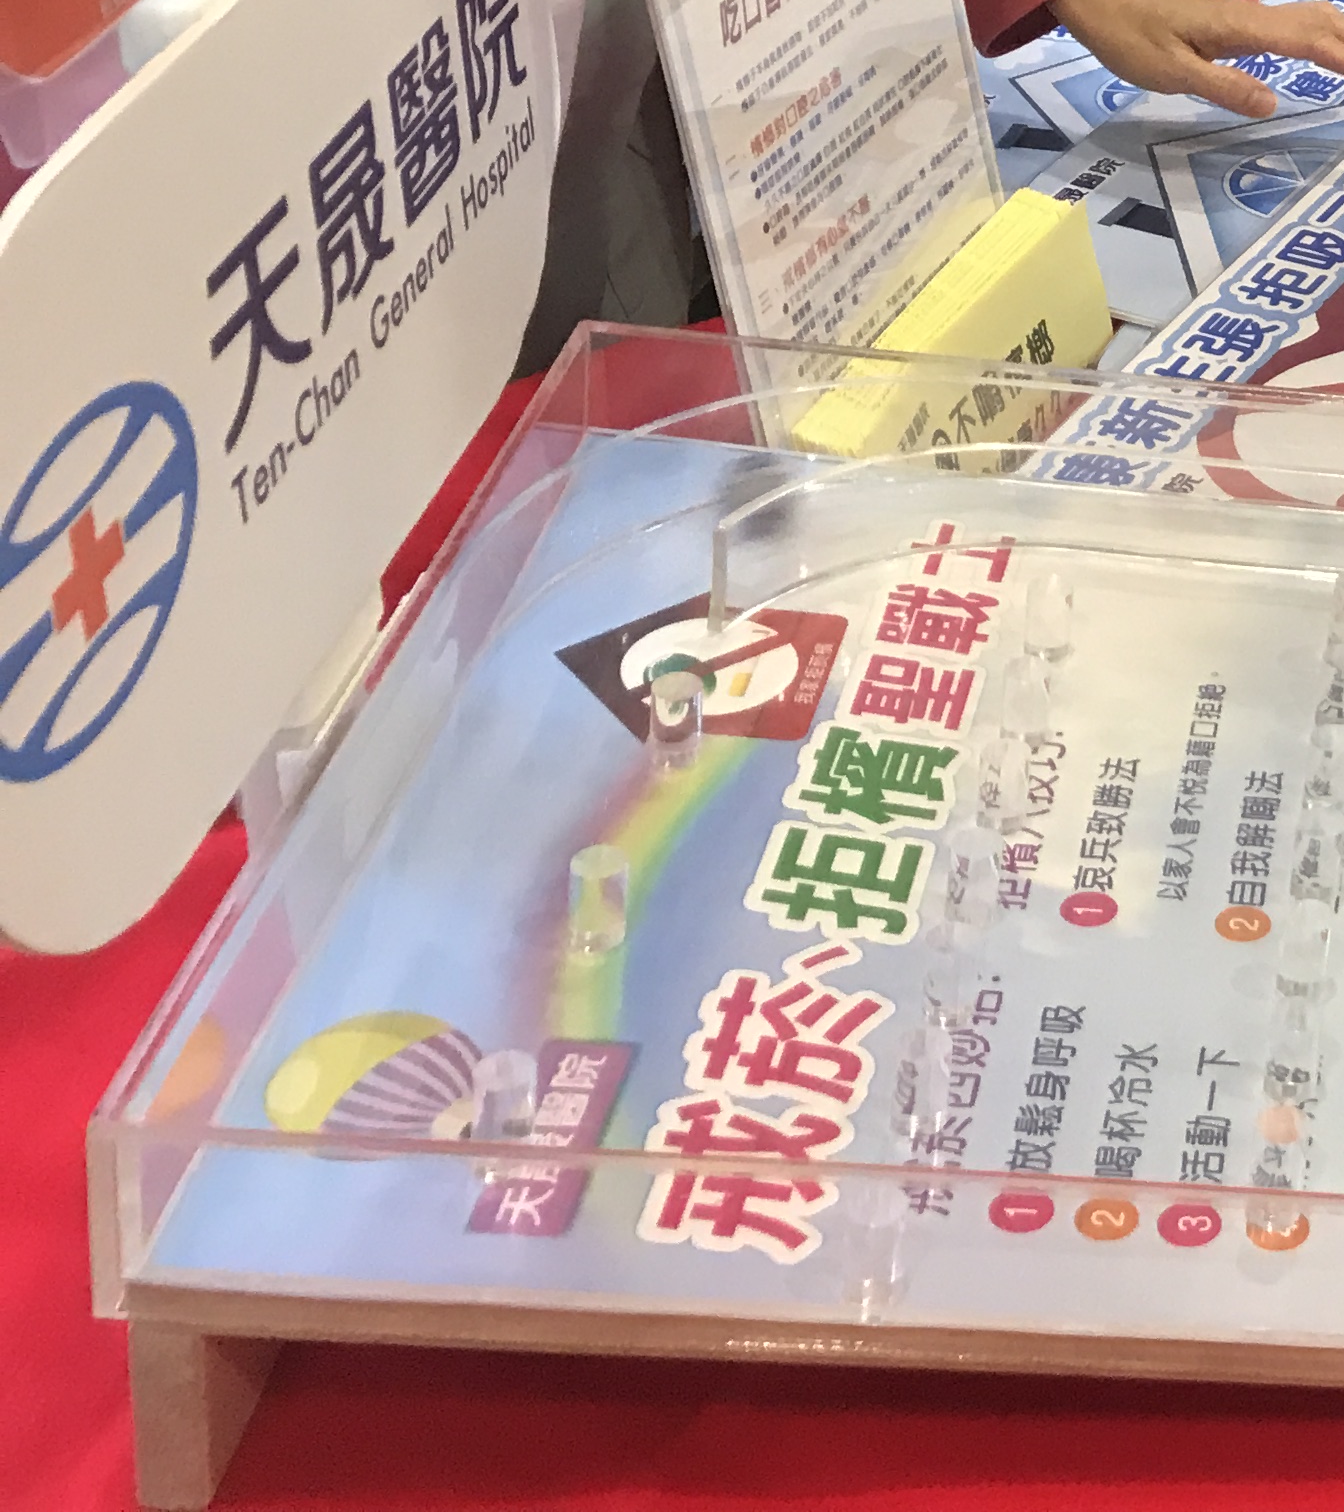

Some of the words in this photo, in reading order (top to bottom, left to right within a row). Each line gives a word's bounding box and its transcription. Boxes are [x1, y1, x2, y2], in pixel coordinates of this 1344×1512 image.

[229, 354, 362, 526] Ten-Chan
[369, 225, 457, 352] General
[460, 97, 538, 237] Hospital
[1072, 756, 1141, 894] 哀兵致勝法
[1226, 770, 1284, 908] 自我解嘲法
[1005, 1003, 1087, 1175] 放鬆身呼吸
[1094, 1042, 1158, 1178] 喝杯冷水
[1179, 1046, 1241, 1183] 活動一下
